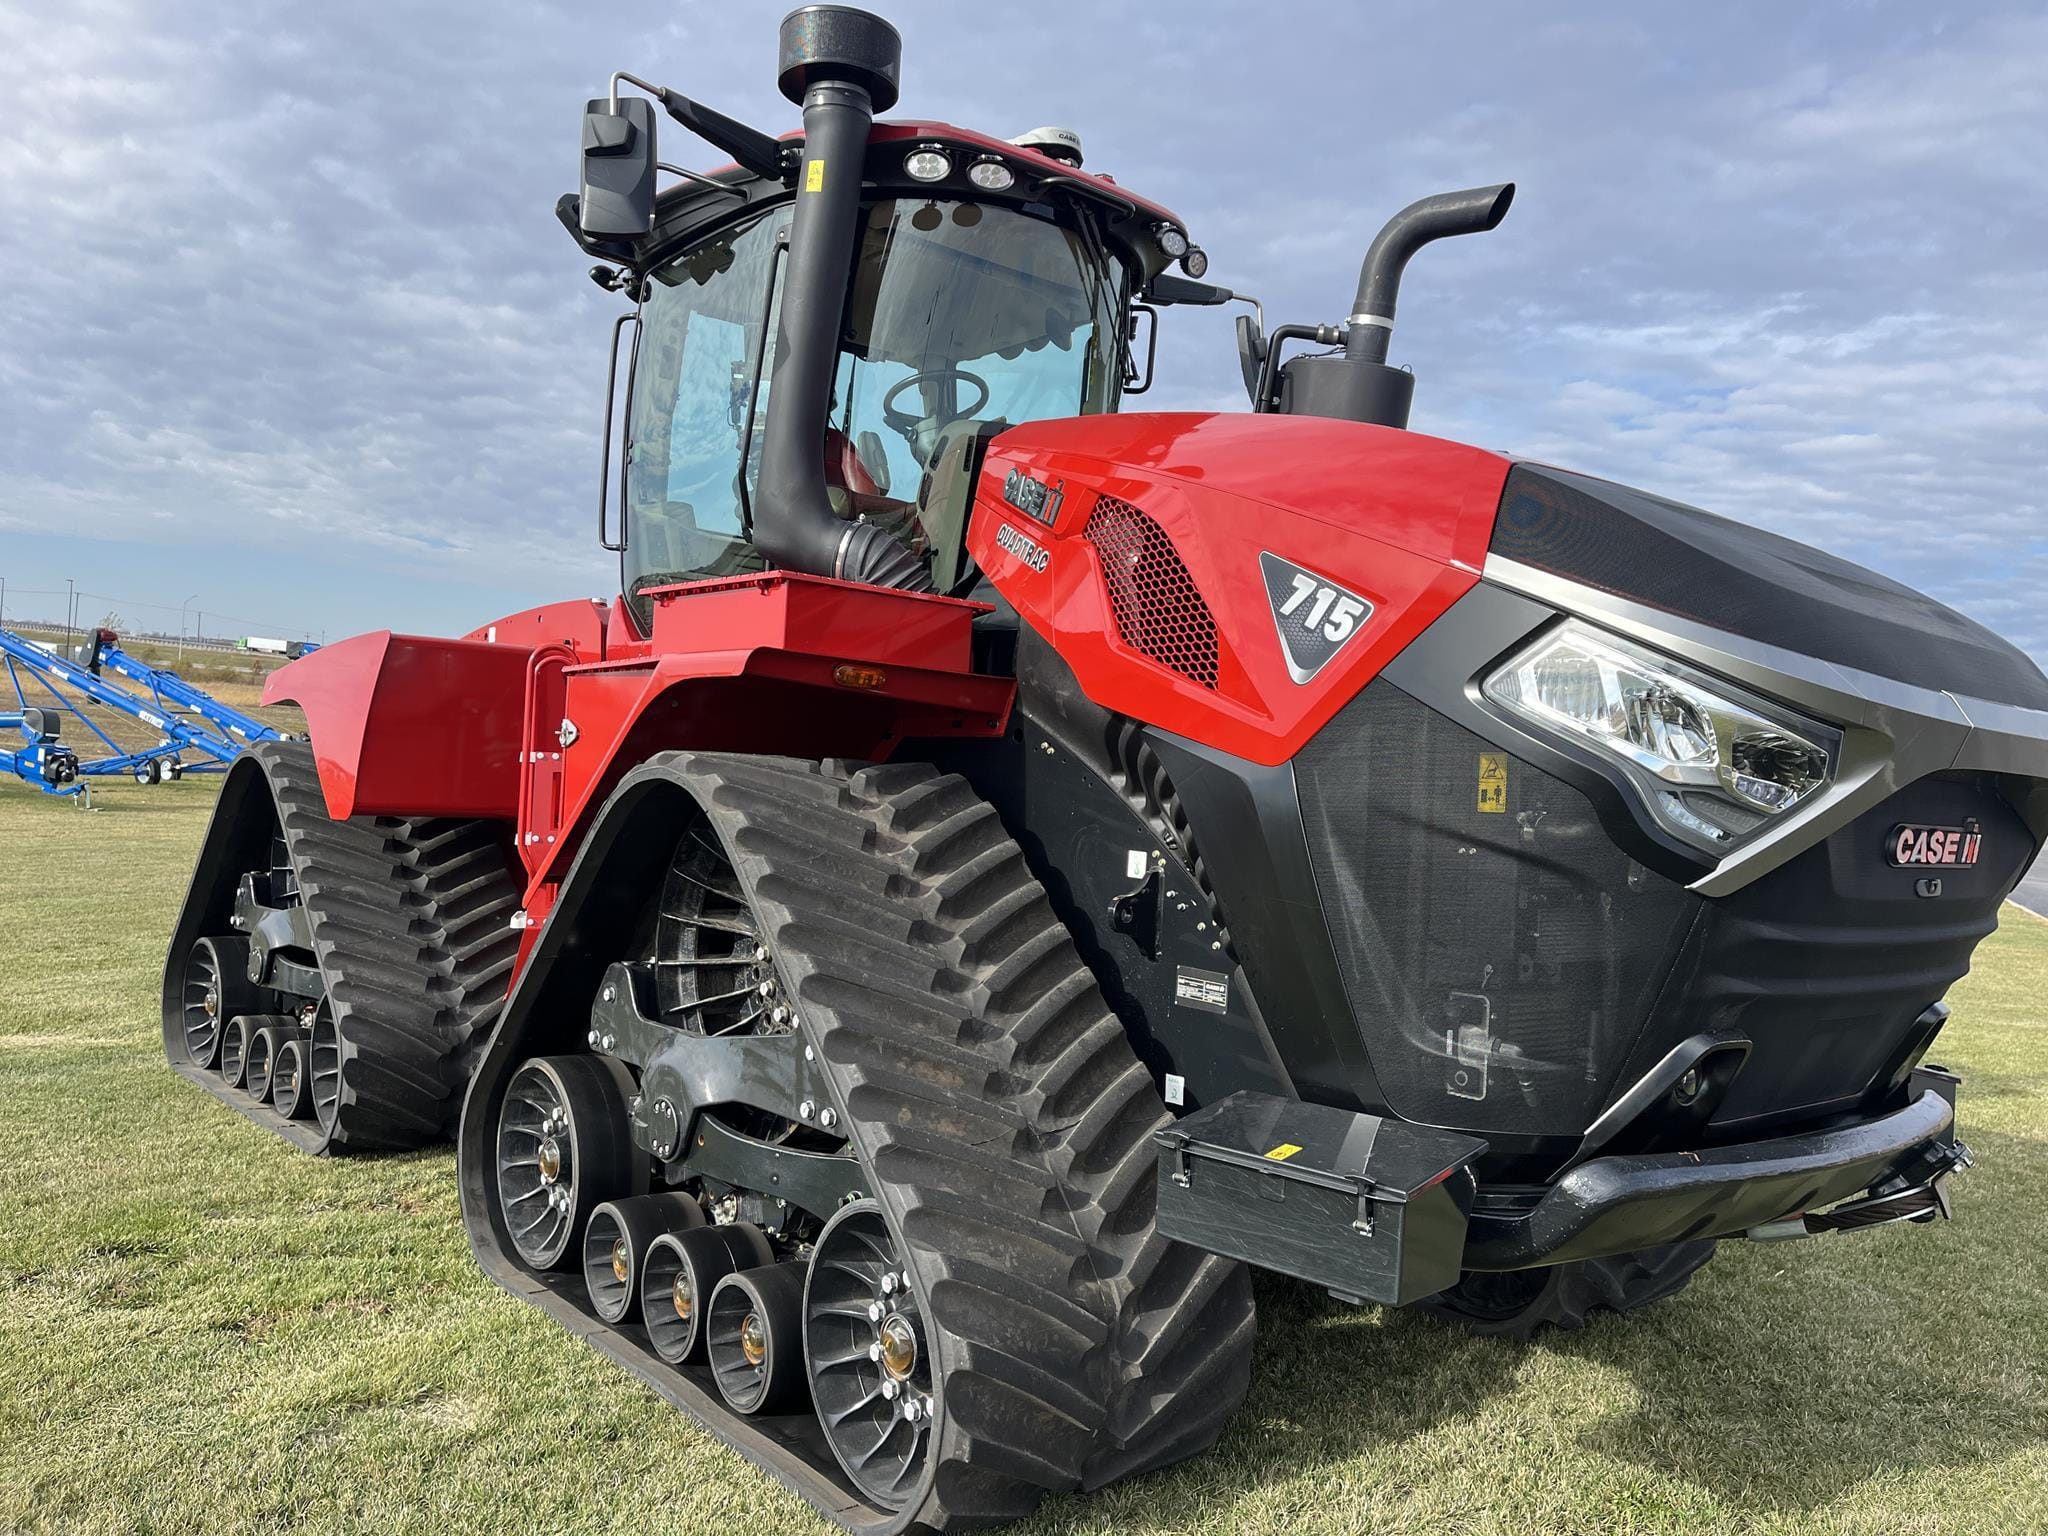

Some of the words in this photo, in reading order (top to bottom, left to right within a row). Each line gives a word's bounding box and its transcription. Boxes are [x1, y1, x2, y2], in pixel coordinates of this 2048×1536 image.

[1058, 133, 1076, 143] CASE
[1003, 467, 1049, 518] CASE
[997, 524, 1049, 574] QUADTRAC
[1278, 573, 1364, 642] 715
[1896, 828, 1961, 864] CASE
